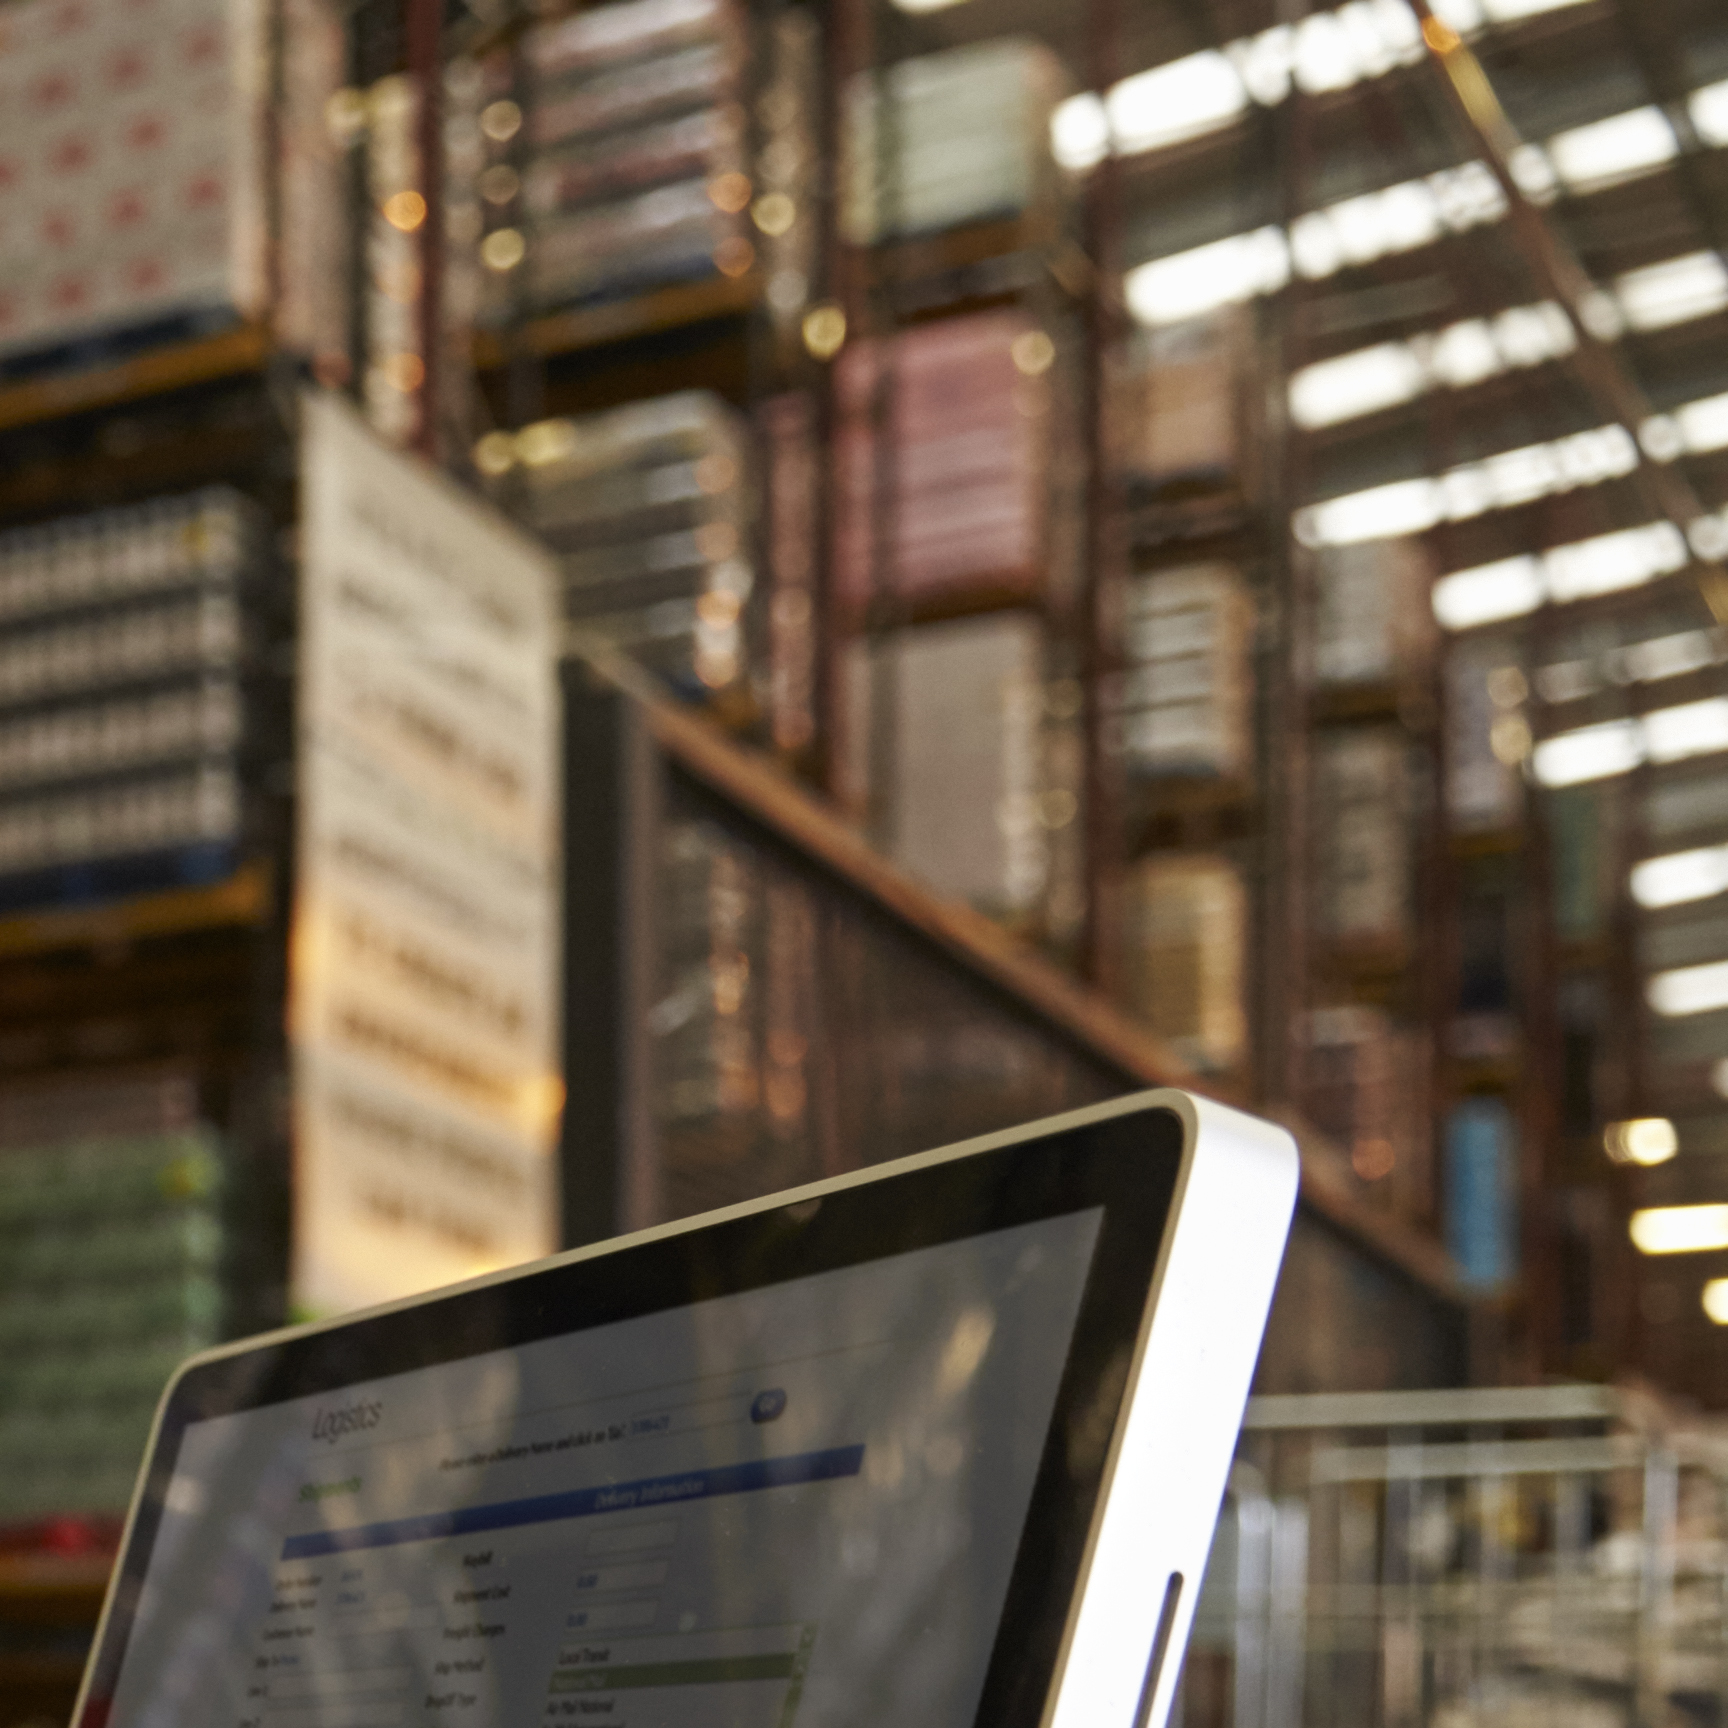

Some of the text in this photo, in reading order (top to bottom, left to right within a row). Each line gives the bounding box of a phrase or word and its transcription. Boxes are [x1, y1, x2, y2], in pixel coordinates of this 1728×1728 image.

[310, 1401, 383, 1446] Logistics
[594, 1479, 705, 1509] Delivery Information
[453, 1658, 485, 1672] Method
[558, 1652, 582, 1665] Local
[546, 1701, 614, 1715] Air Mail National
